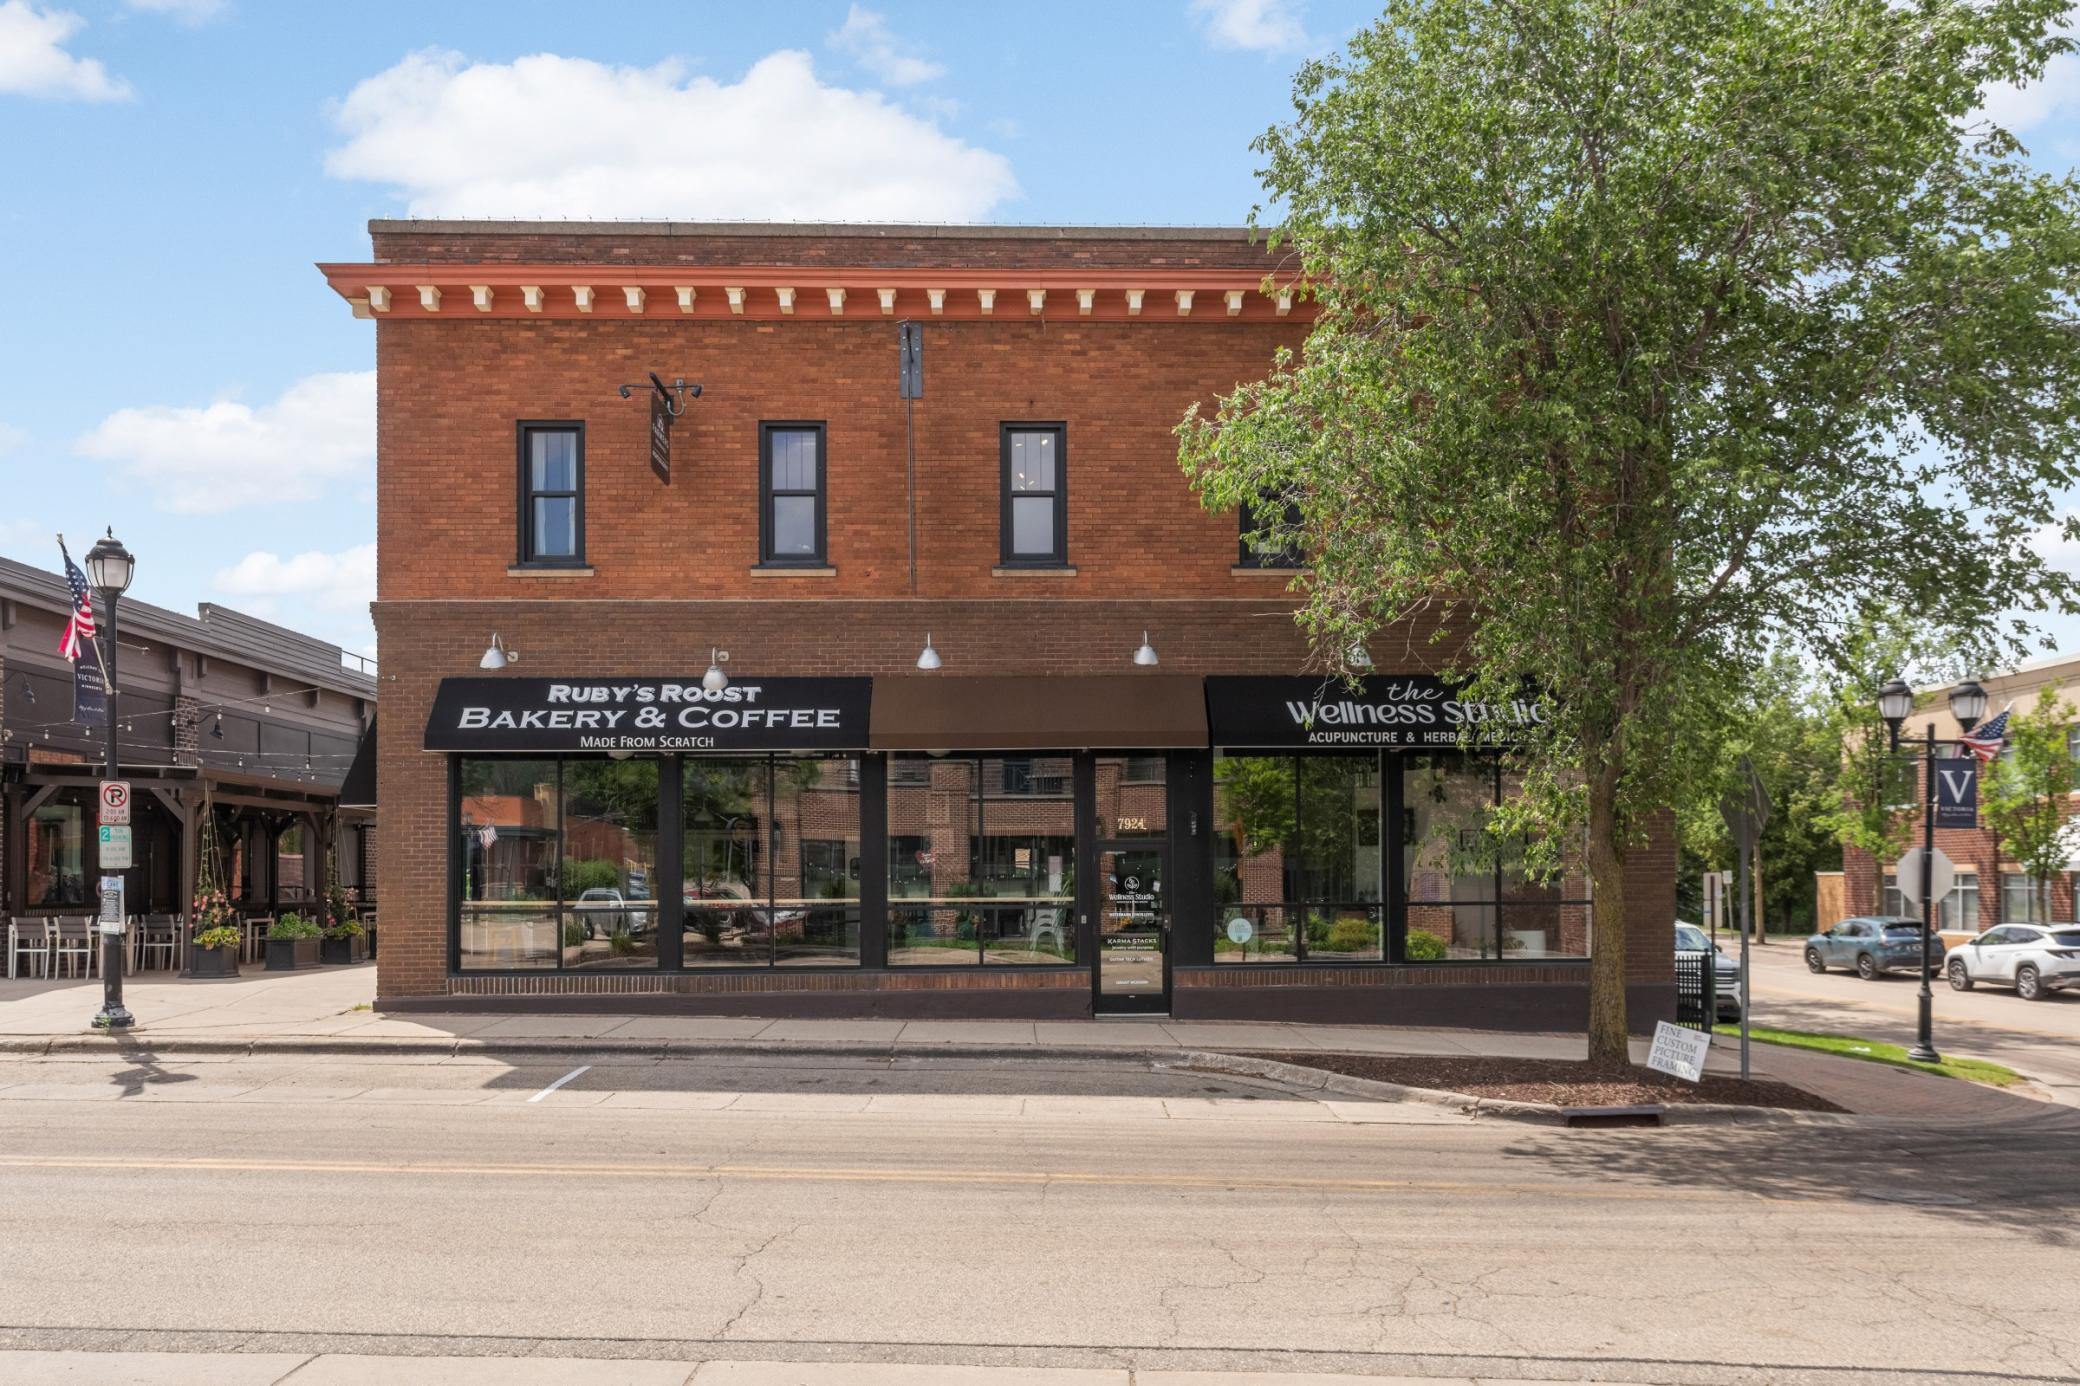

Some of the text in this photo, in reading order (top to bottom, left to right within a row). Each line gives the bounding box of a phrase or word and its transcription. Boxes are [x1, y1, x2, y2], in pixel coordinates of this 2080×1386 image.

[547, 684, 762, 703] RUBY'S ROOST
[1387, 680, 1444, 701] the
[457, 706, 841, 729] BAKERY & COFFEE
[1286, 701, 1436, 724] Wellness
[580, 735, 714, 748] MADE FROM SCRATCH
[1308, 732, 1398, 743] ACUPUNCTURE
[1406, 731, 1416, 743] &
[1423, 731, 1475, 743] HERB
[1939, 770, 1974, 804] V
[1117, 817, 1148, 830] 7924
[101, 828, 109, 840] 2
[1660, 1024, 1682, 1038] FINE
[1657, 1035, 1698, 1055] CUSTOM
[1654, 1046, 1696, 1065] PICTURE
[1651, 1056, 1697, 1077] FRAMING
